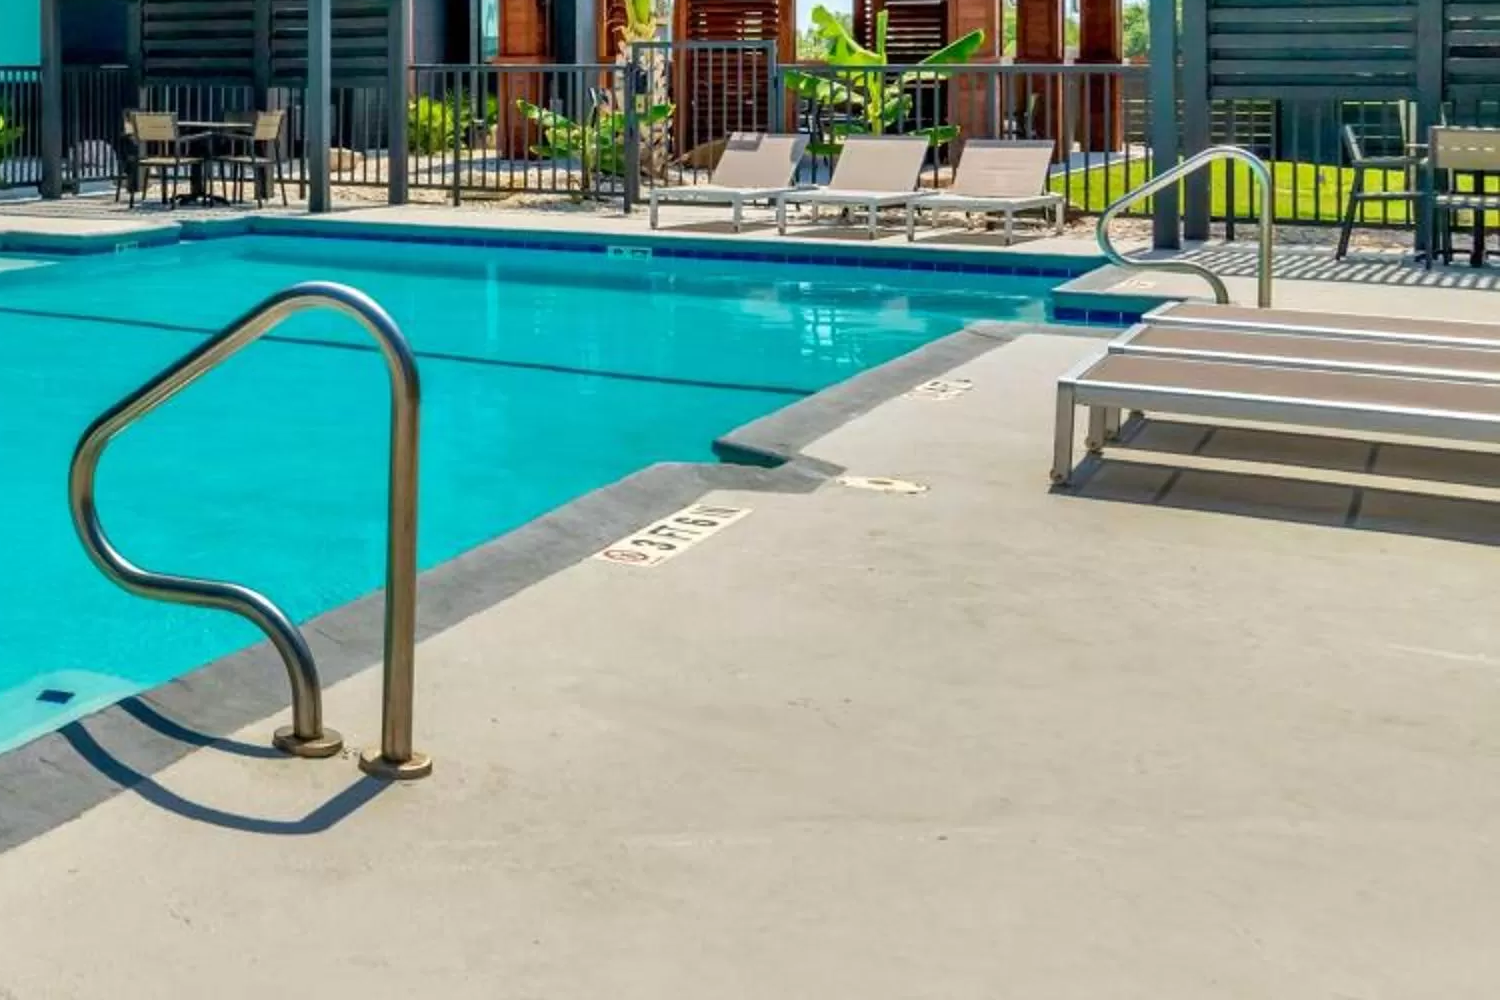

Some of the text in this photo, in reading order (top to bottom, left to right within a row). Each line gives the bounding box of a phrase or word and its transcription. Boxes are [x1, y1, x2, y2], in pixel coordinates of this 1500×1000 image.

[630, 505, 741, 551] 3 FT 6 IN
